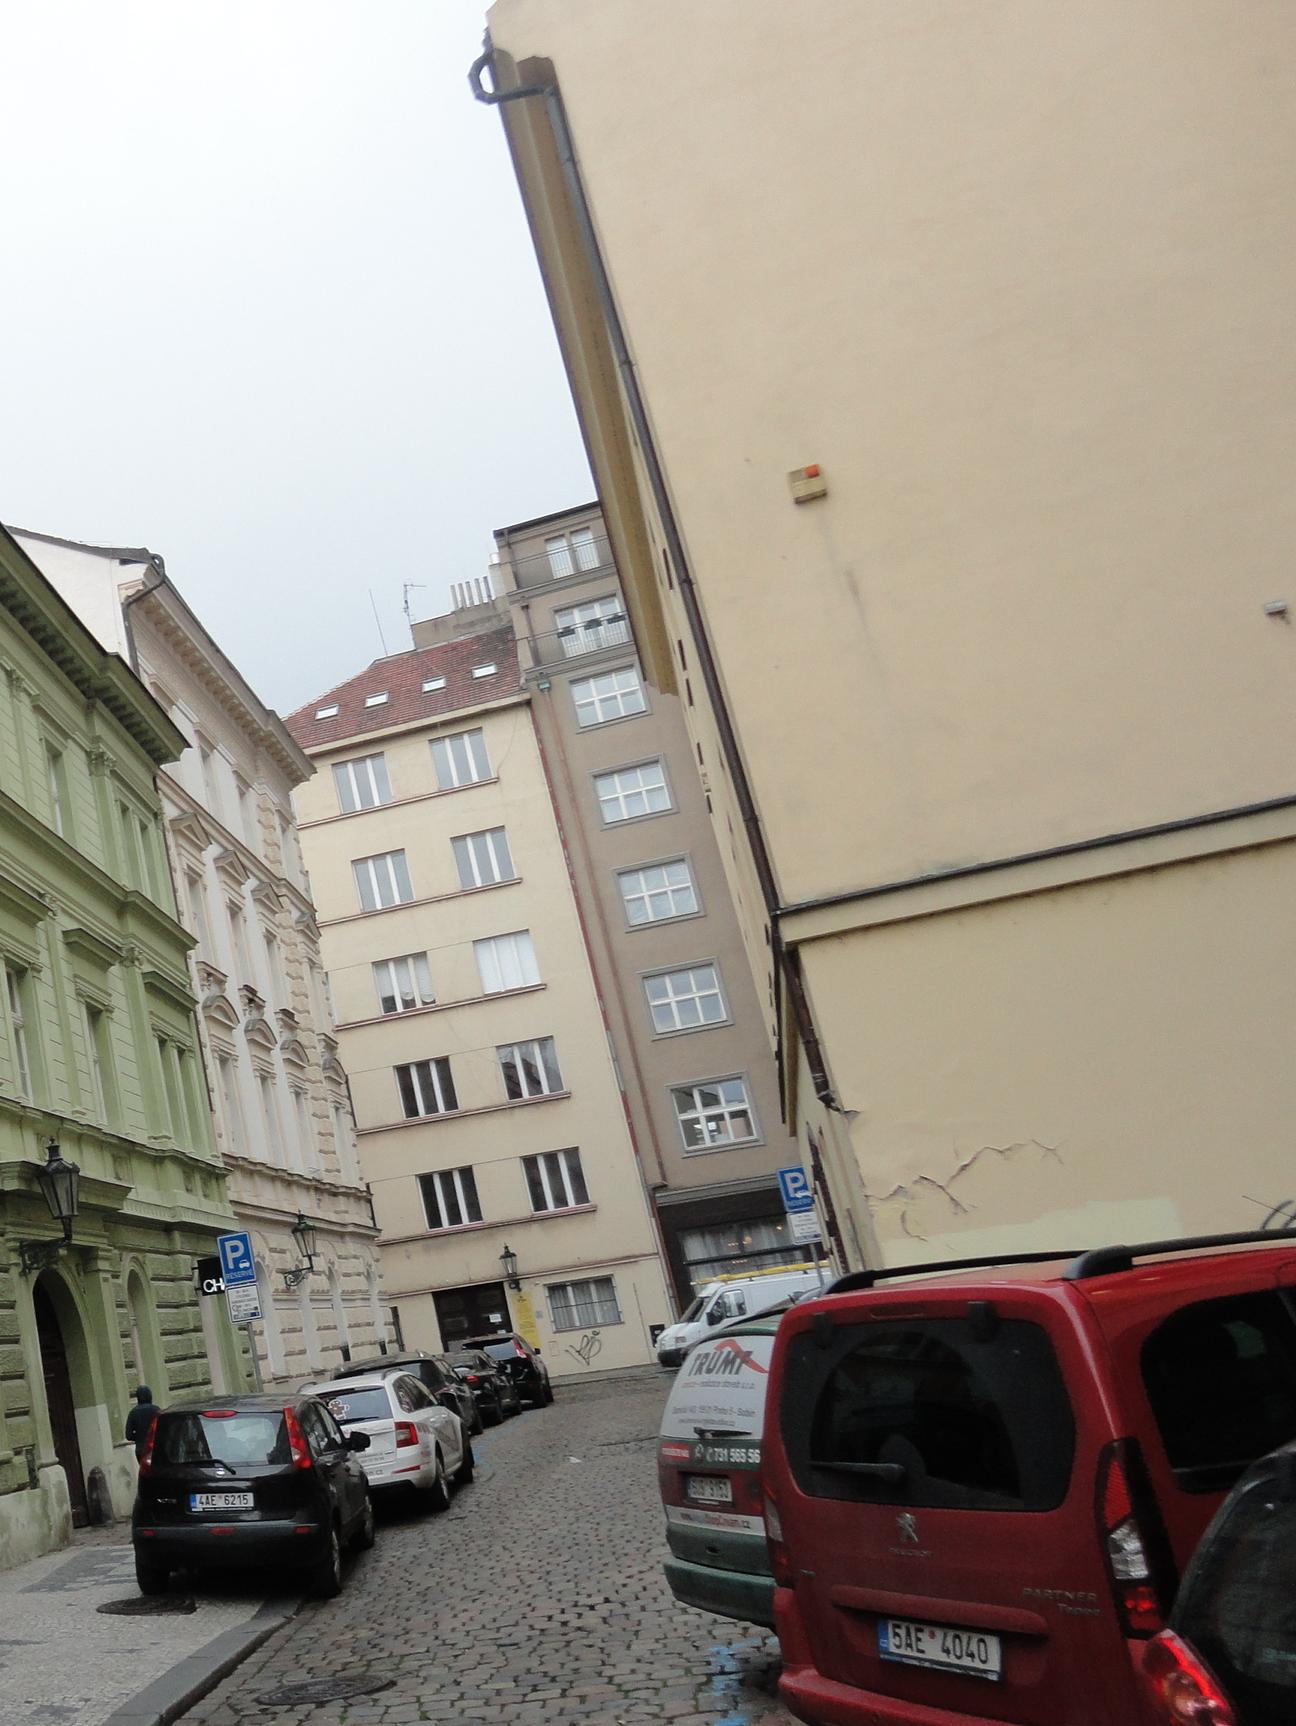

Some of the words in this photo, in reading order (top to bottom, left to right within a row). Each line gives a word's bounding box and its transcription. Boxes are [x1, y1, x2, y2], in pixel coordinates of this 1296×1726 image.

[785, 1172, 804, 1198] P
[224, 1240, 244, 1269] P
[198, 1495, 217, 1506] 4AE
[224, 1494, 249, 1507] 6215
[892, 1623, 926, 1655] 5AE
[940, 1631, 989, 1665] 4040
